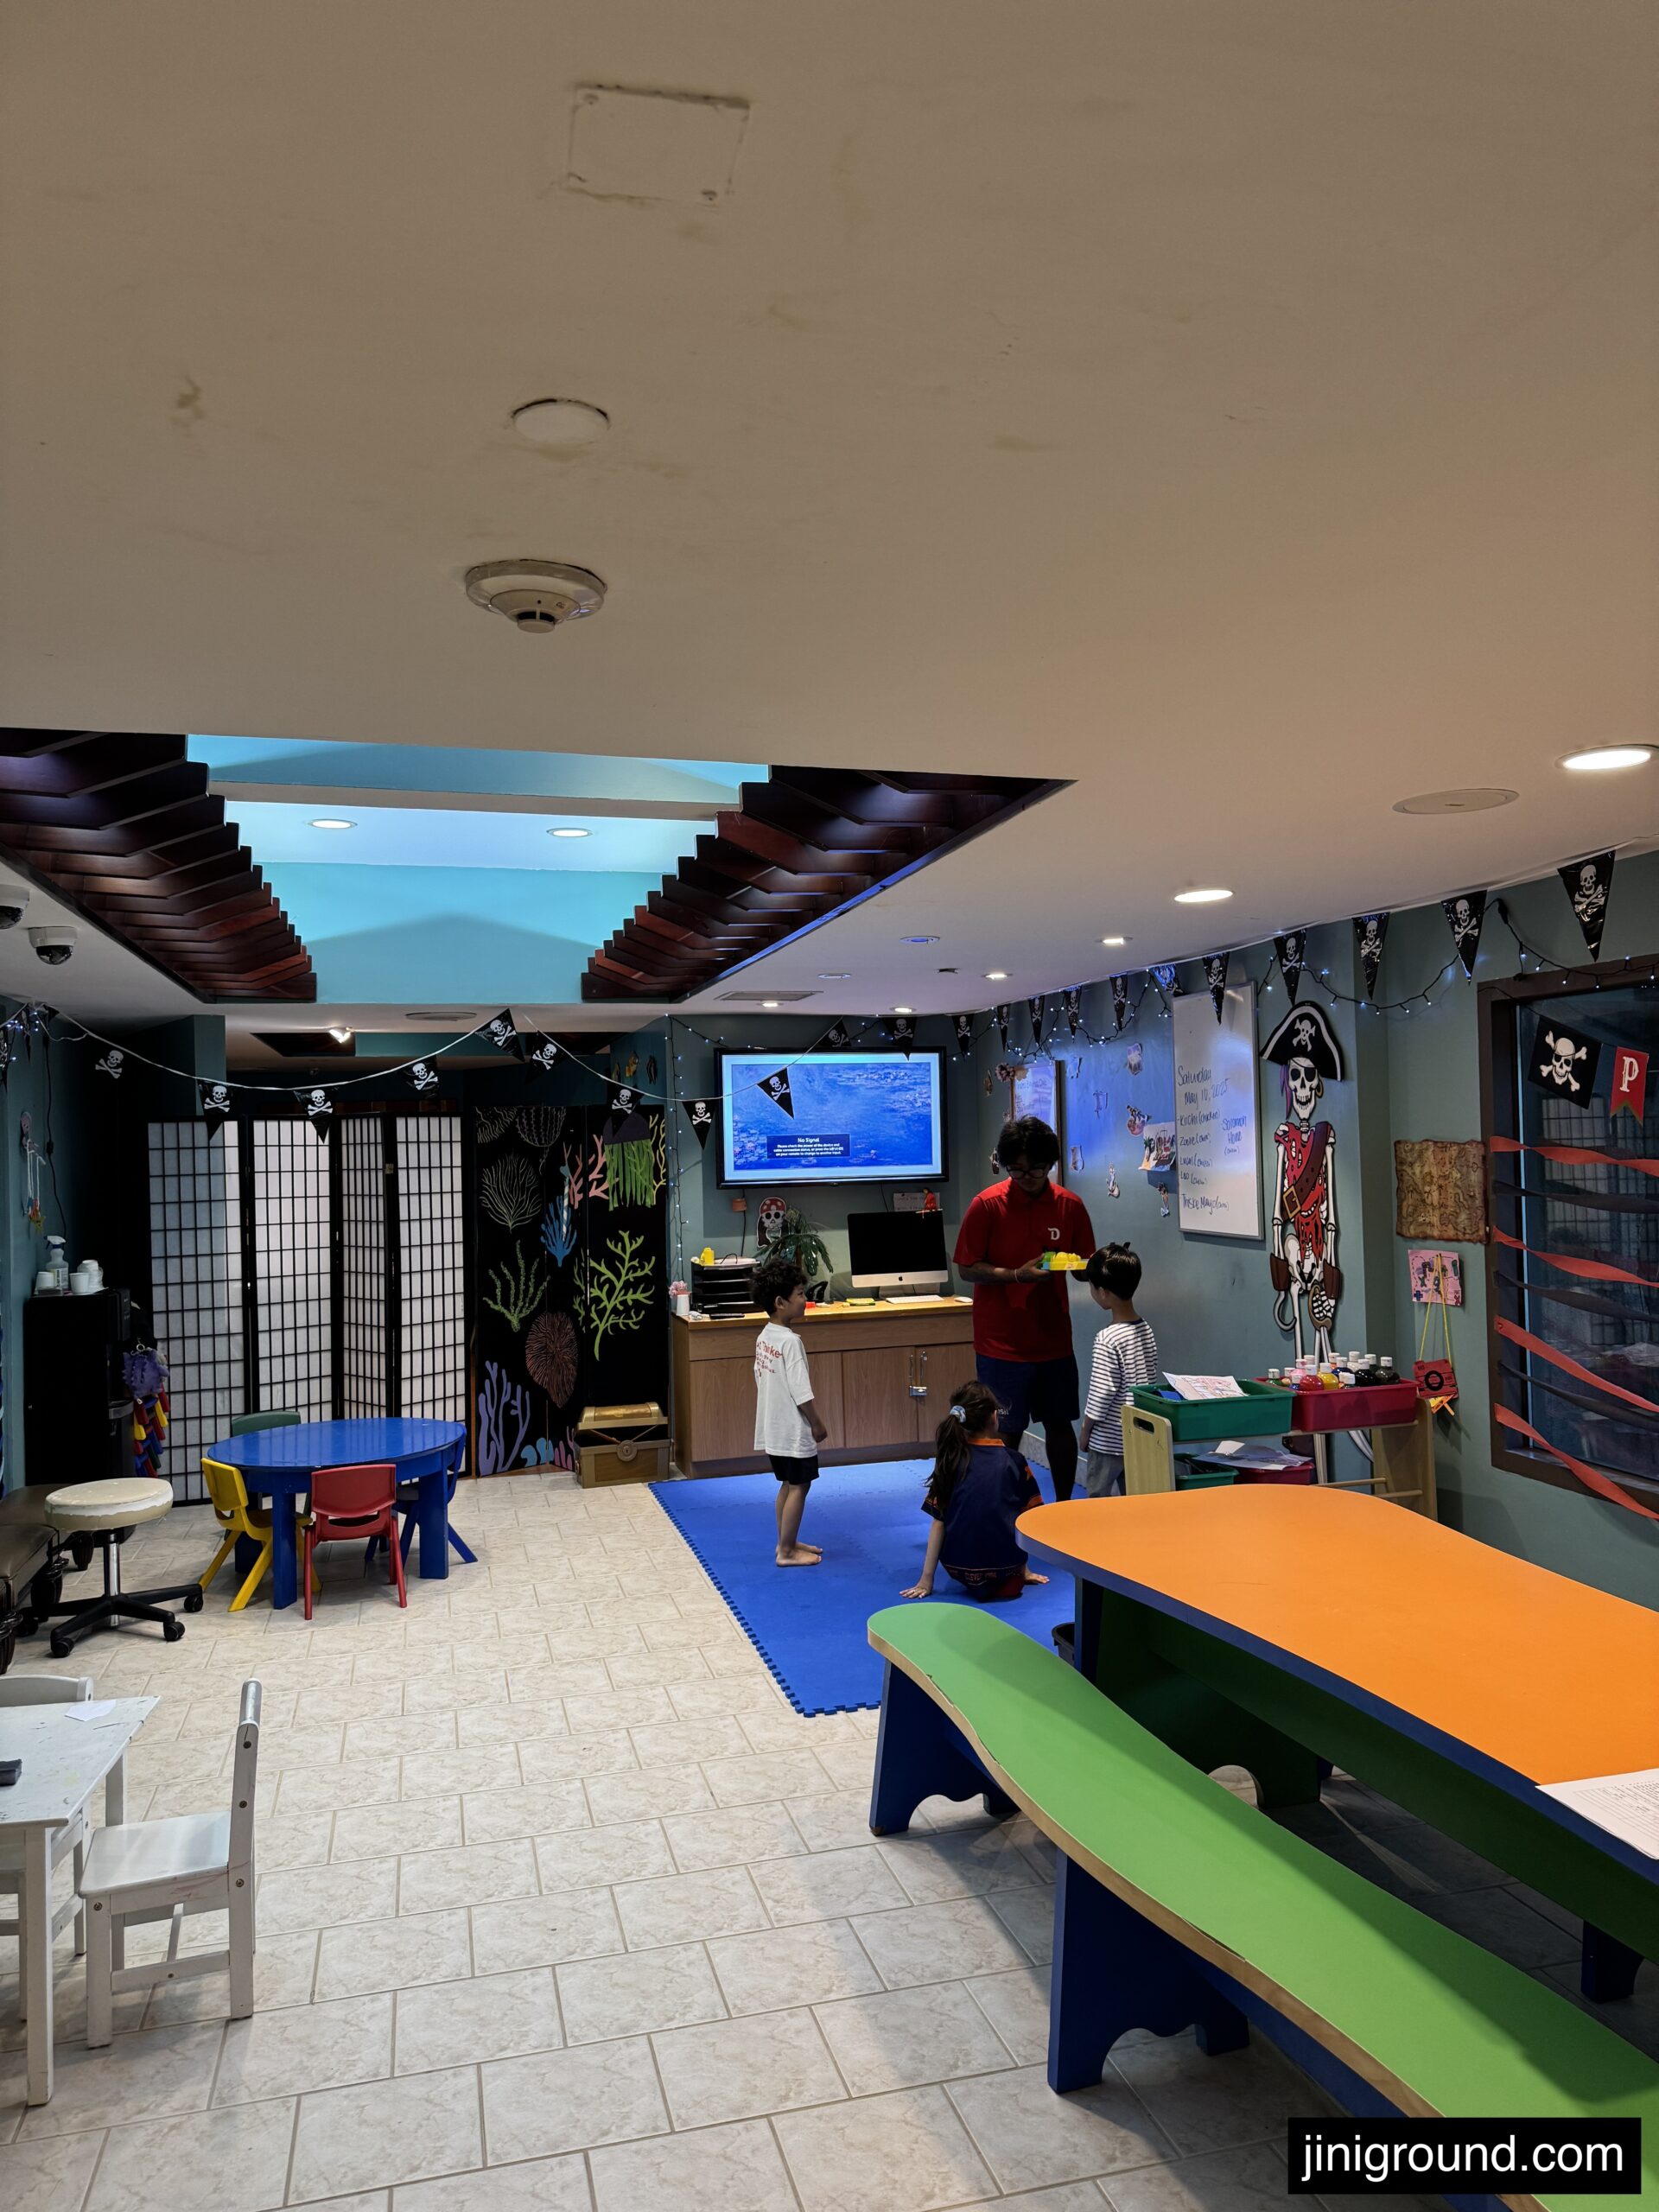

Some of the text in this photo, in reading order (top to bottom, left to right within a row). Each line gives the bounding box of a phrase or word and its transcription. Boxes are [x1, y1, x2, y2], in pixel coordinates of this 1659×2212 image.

[1178, 1065, 1211, 1086] Saturday
[1619, 1056, 1639, 1092] P
[1047, 1227, 1061, 1241] D
